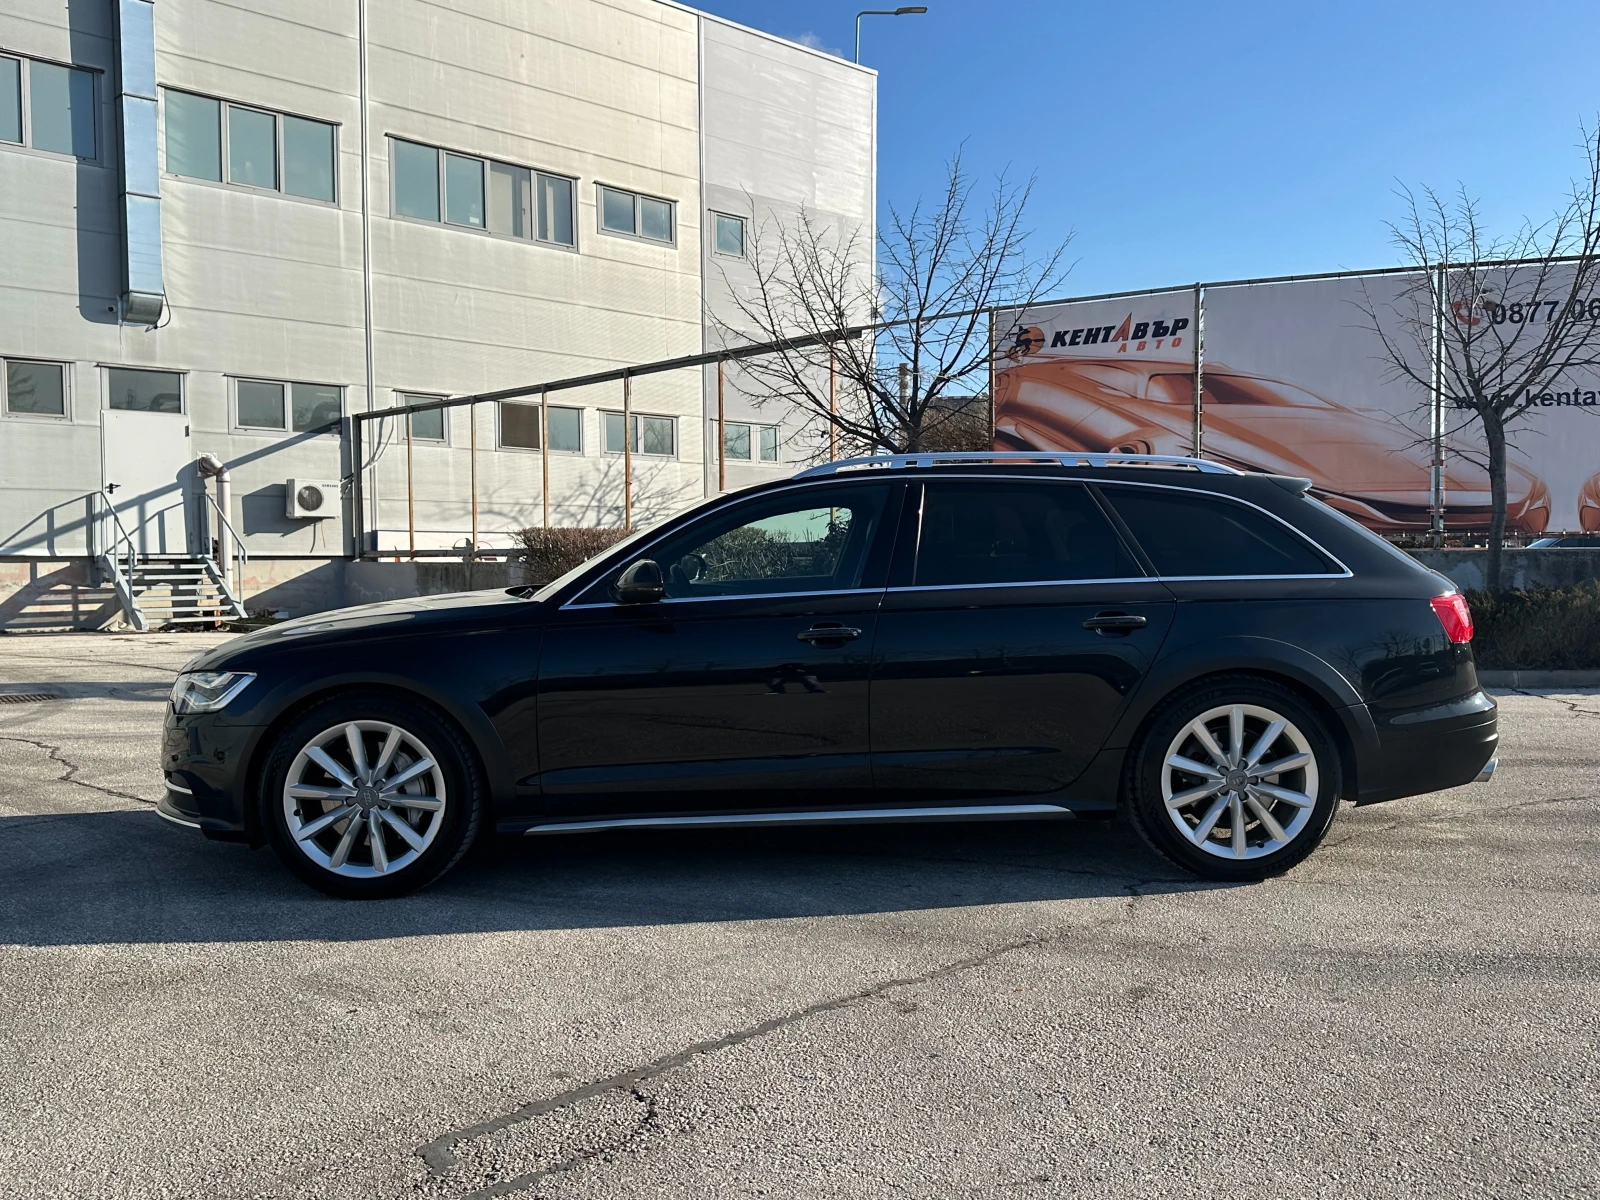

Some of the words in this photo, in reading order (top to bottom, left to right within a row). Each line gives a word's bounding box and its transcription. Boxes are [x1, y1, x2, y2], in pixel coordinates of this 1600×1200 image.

[1491, 300, 1560, 325] 0877
[1050, 311, 1189, 348] КЕНТАВЪР
[1117, 337, 1182, 353] АВТО
